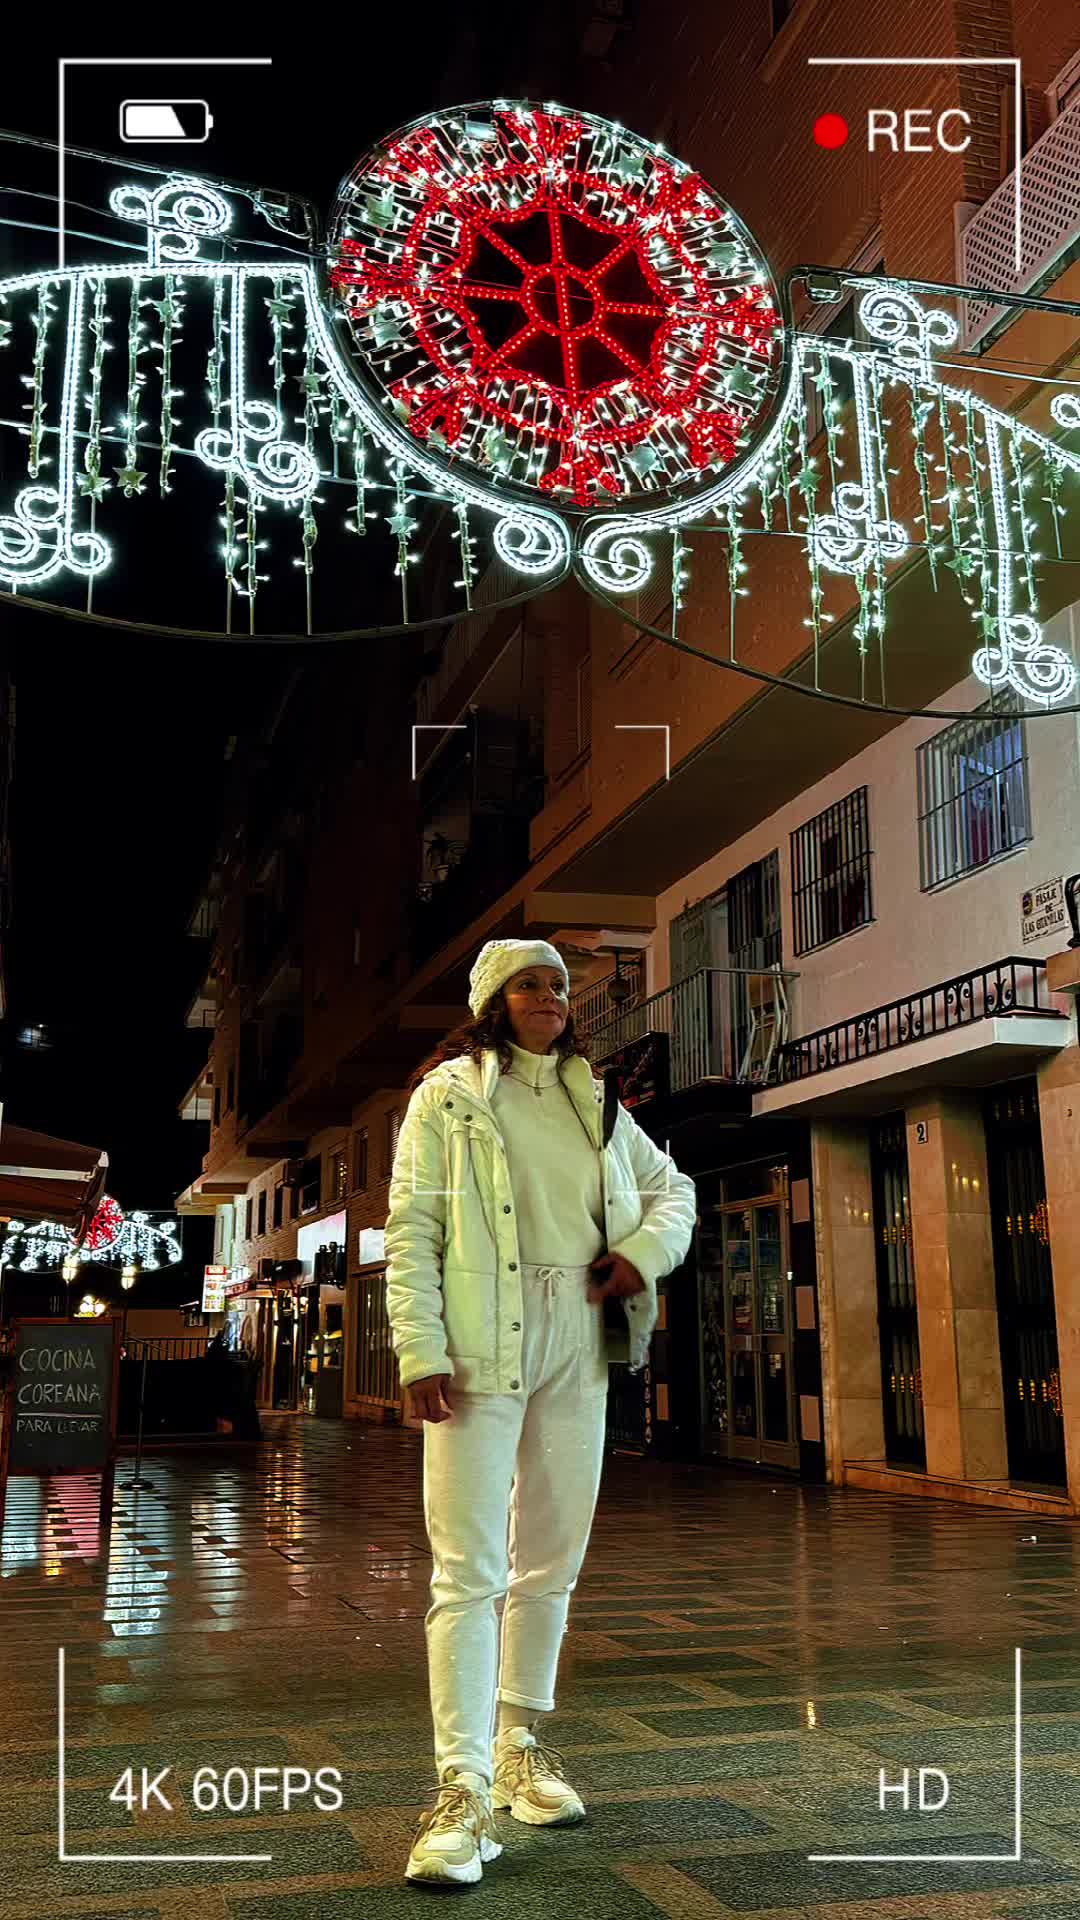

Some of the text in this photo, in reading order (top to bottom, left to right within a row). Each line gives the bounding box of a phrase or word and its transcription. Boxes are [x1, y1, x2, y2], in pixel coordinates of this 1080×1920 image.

[1035, 888, 1056, 907] PASAJE
[1045, 903, 1053, 914] DE
[1025, 921, 1035, 935] LAS
[917, 1124, 925, 1142] 2
[19, 1348, 97, 1372] COCINA
[17, 1383, 101, 1405] COREANA
[16, 1419, 53, 1433] PARA
